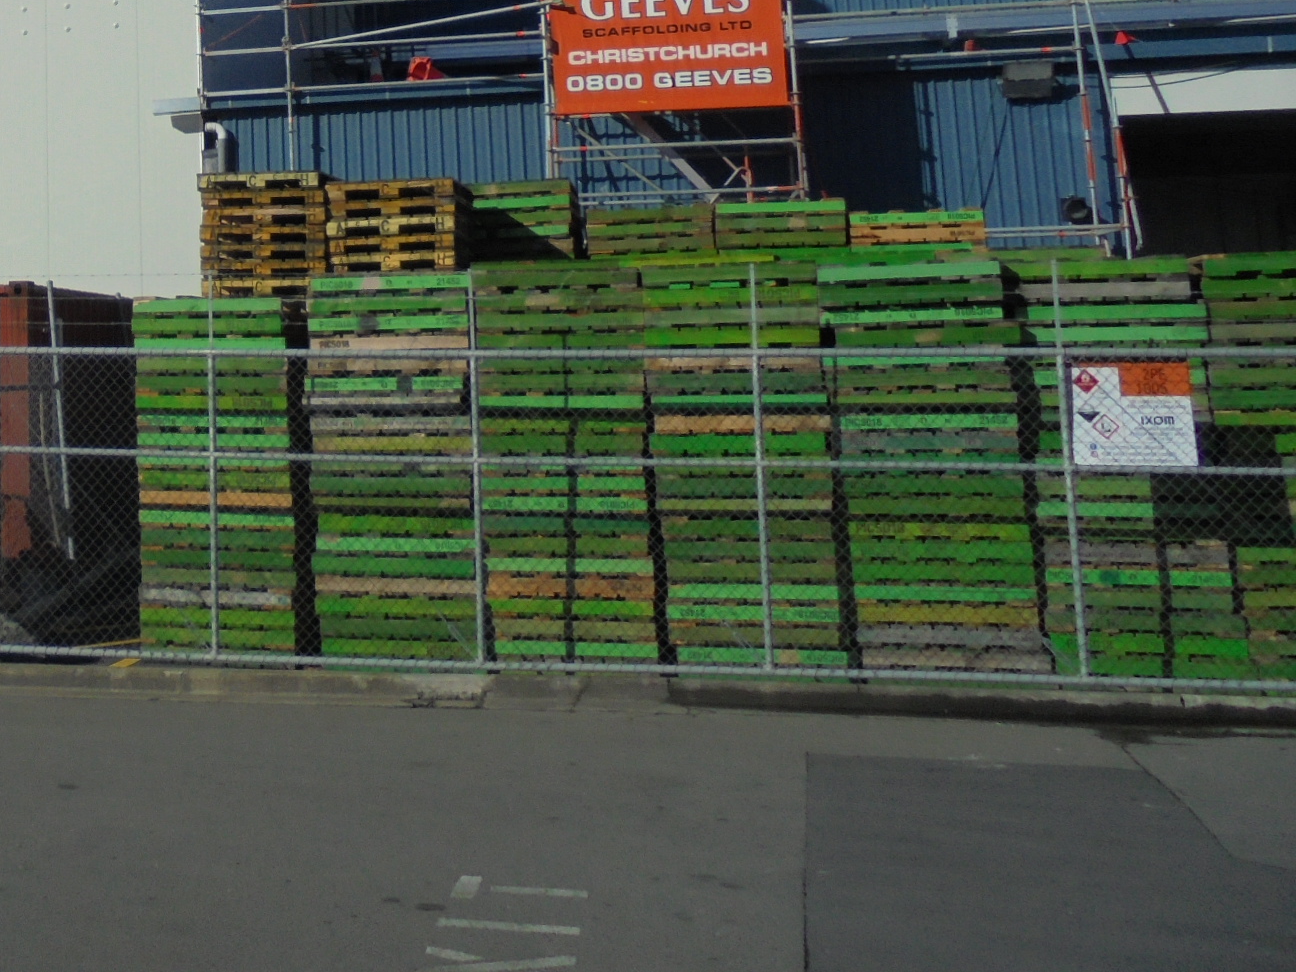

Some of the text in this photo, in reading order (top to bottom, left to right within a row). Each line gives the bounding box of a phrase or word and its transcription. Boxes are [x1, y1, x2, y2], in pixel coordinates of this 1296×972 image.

[583, 20, 752, 38] SCAFFOLDING LTD
[568, 42, 767, 65] CHRISTCHURCH
[566, 67, 773, 92] 0800 GEEVES
